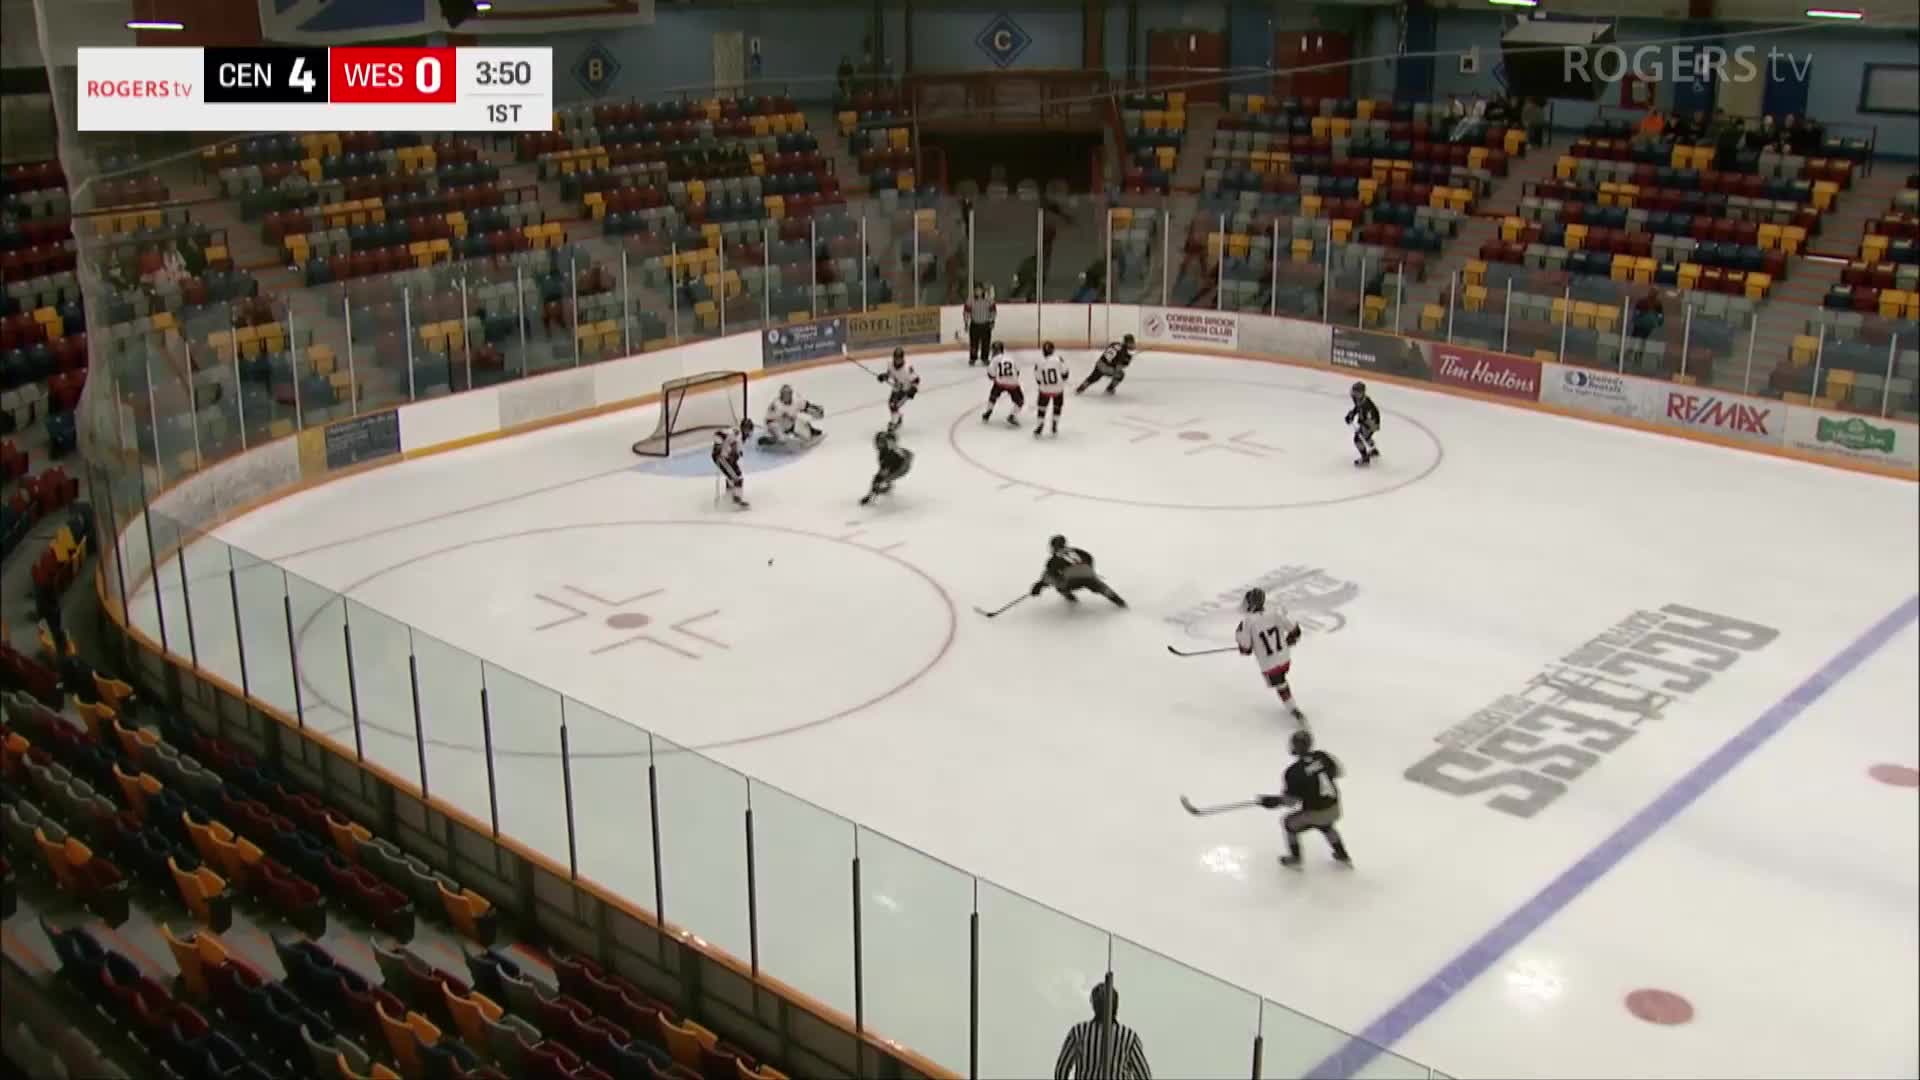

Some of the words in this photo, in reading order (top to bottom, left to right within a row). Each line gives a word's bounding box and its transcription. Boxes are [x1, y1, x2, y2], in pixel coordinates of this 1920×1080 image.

[994, 30, 1011, 51] C
[1166, 313, 1202, 325] CORNER
[1204, 316, 1236, 328] BROOK
[1209, 326, 1233, 337] CLUB
[998, 361, 1013, 377] 12
[1041, 368, 1058, 385] 10
[1439, 354, 1469, 379] Tim
[1470, 359, 1534, 393] Hortons
[1666, 391, 1771, 436] RE/MAX
[1259, 625, 1283, 656] 17
